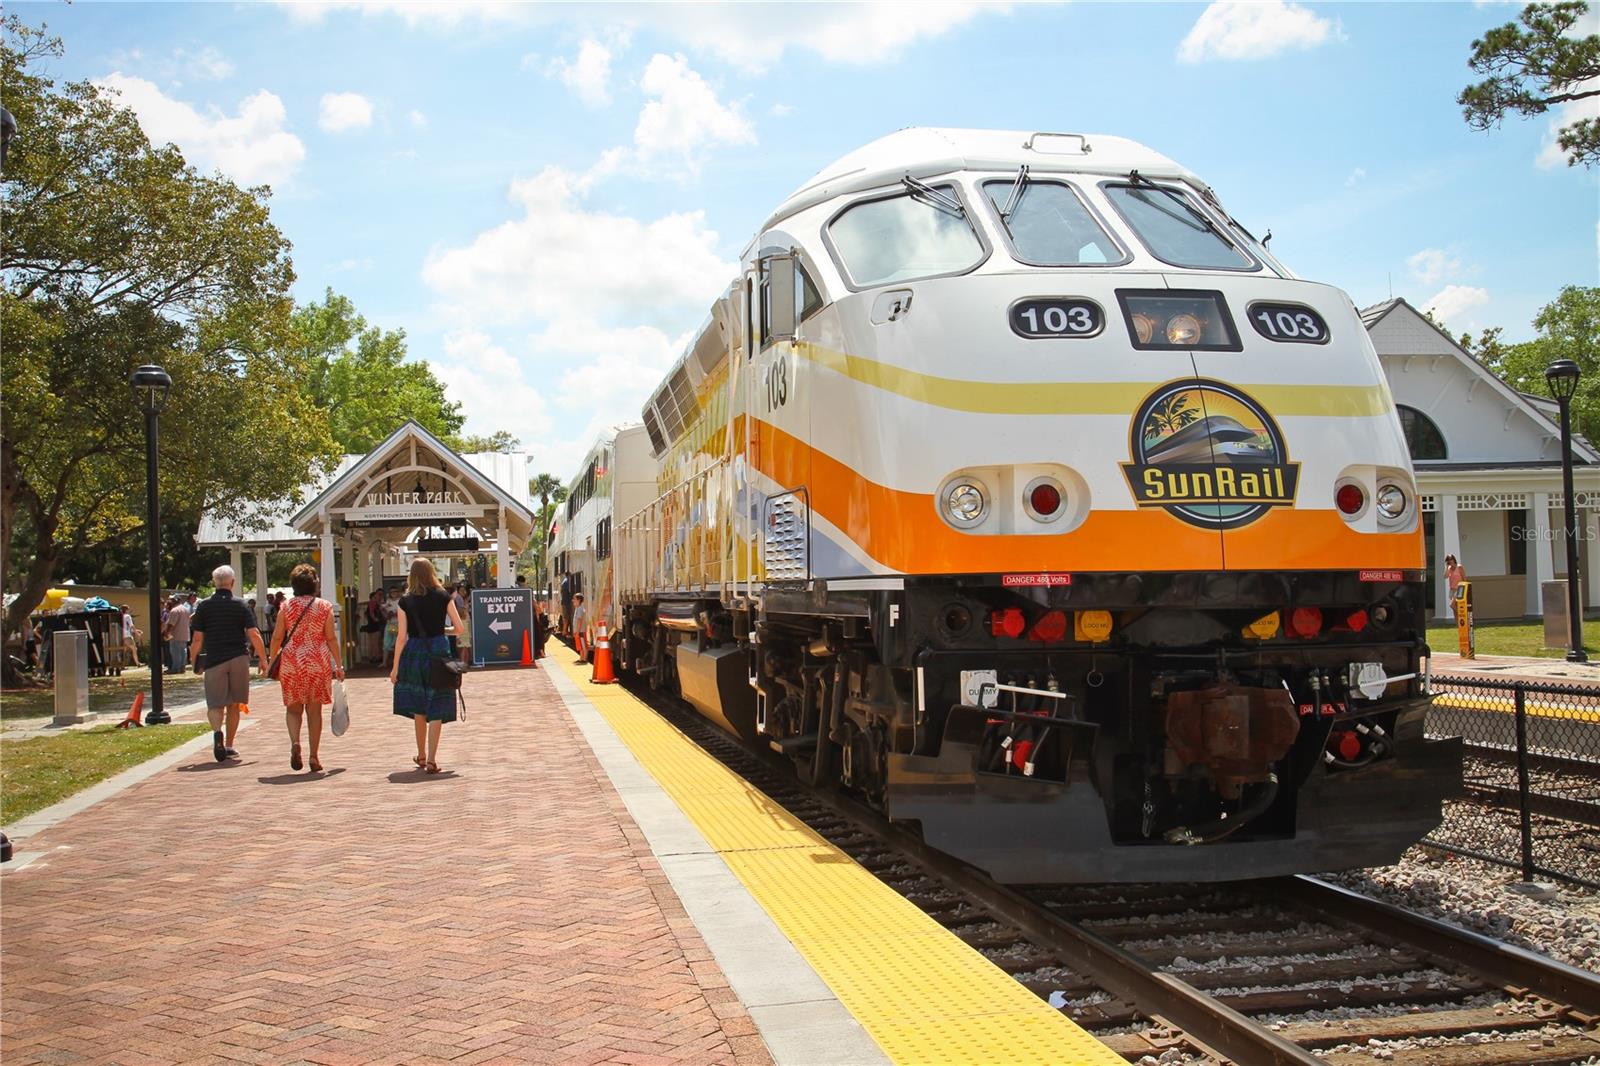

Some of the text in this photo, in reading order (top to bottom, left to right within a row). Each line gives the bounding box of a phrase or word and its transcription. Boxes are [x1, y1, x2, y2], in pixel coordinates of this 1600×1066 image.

[1021, 307, 1093, 332] 103
[1258, 311, 1319, 338] 103
[765, 357, 788, 412] 103
[1143, 467, 1285, 498] SunRail
[367, 491, 462, 505] WINTER PARK
[1006, 575, 1034, 584] DANGER
[1050, 574, 1067, 583] Volts
[1362, 572, 1382, 580] DANGER
[487, 603, 516, 613] EXIT
[889, 604, 900, 628] F
